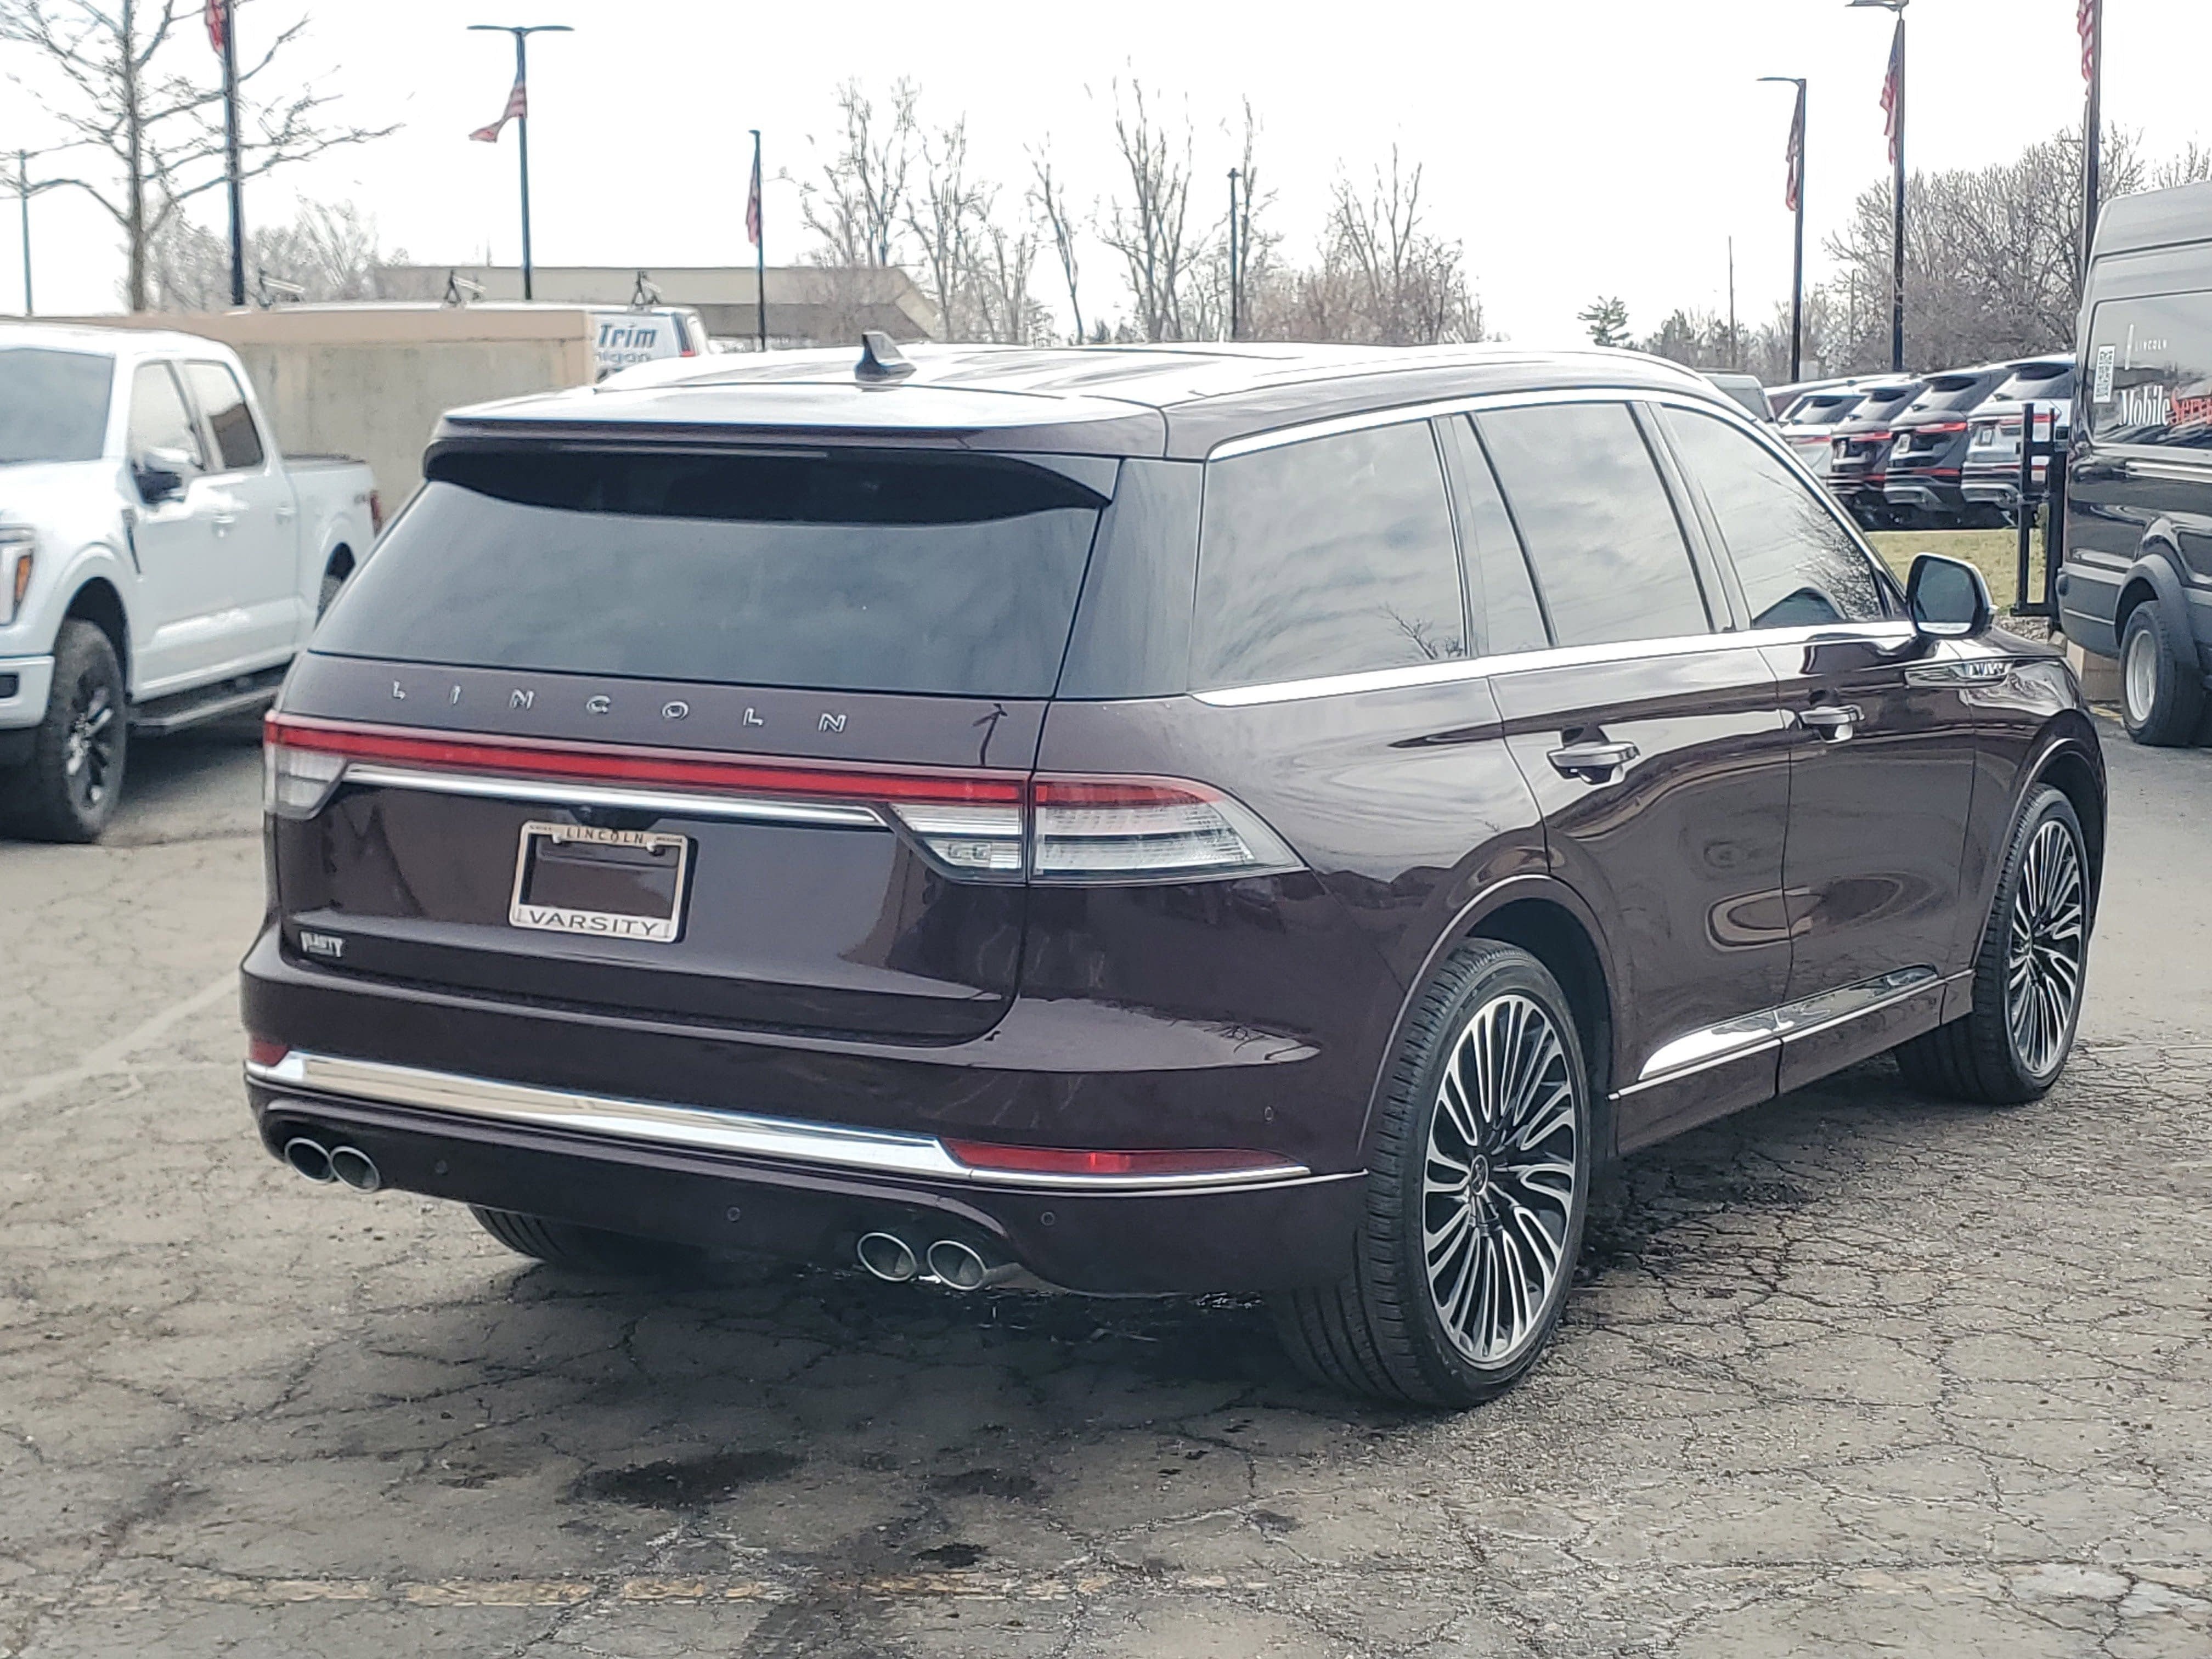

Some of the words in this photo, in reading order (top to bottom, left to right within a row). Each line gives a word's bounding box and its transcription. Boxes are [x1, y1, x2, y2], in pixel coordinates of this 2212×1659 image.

[599, 323, 658, 347] Trim
[2118, 385, 2170, 427] Mobile
[393, 681, 848, 733] LINCOLN
[566, 827, 644, 844] LINCOLN
[529, 910, 659, 936] VARSITY
